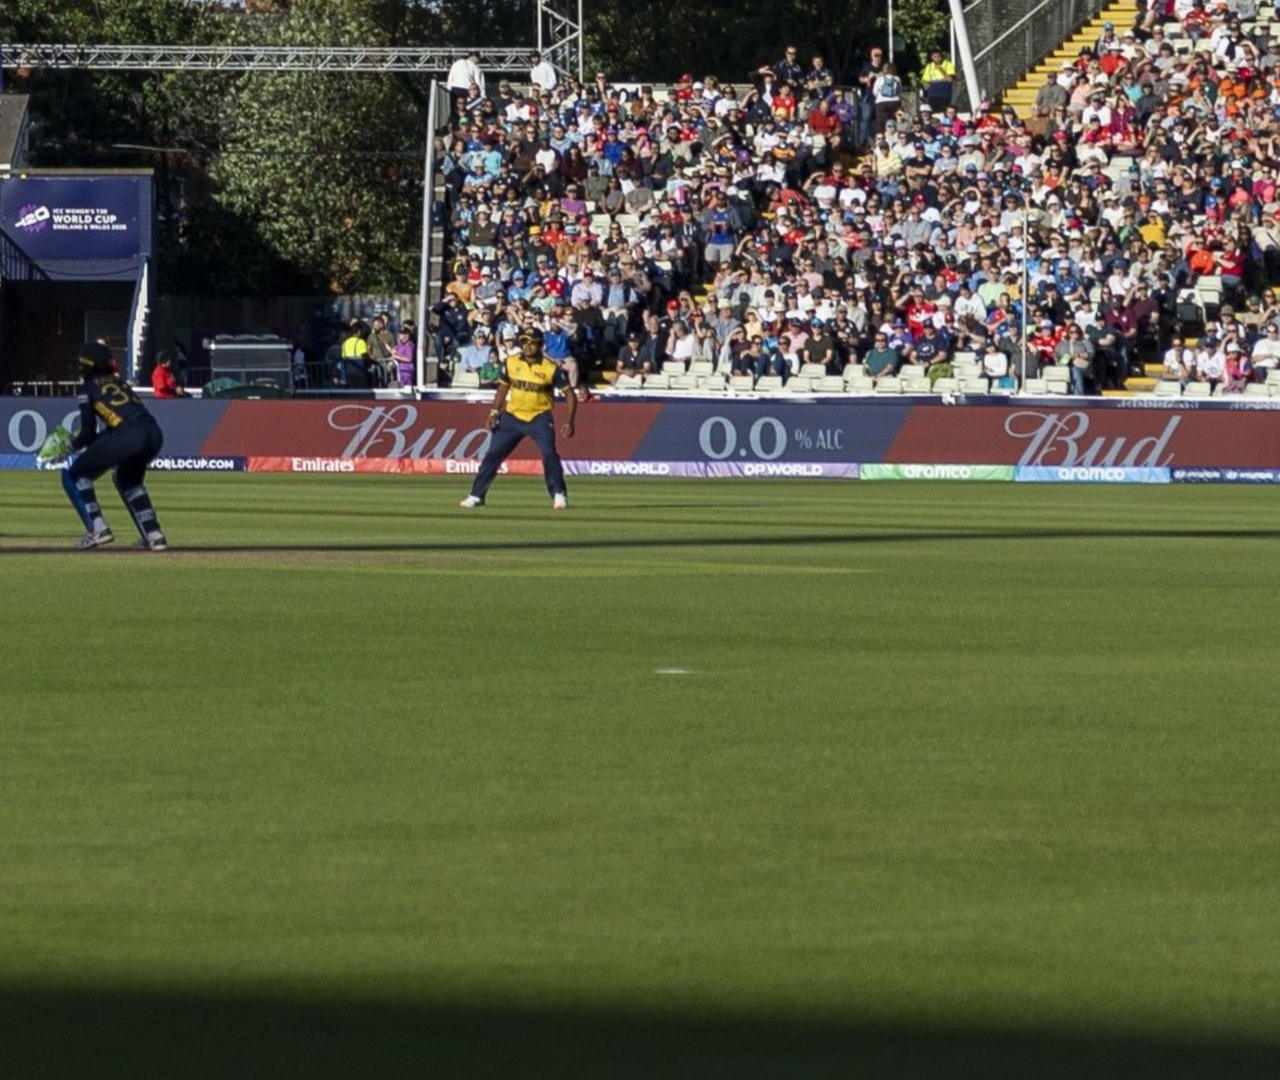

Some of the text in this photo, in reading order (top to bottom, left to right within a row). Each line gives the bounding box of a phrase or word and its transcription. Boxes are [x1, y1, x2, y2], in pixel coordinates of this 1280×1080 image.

[52, 215, 117, 224] WORLD CUP
[698, 416, 844, 460] 0.0 % ALC
[1004, 411, 1182, 468] Bud
[292, 457, 354, 472] Emirates
[591, 463, 670, 475] DP WORLD
[745, 464, 824, 476] DP WORLD
[905, 466, 971, 478] aramco
[1058, 468, 1125, 481] aramco
